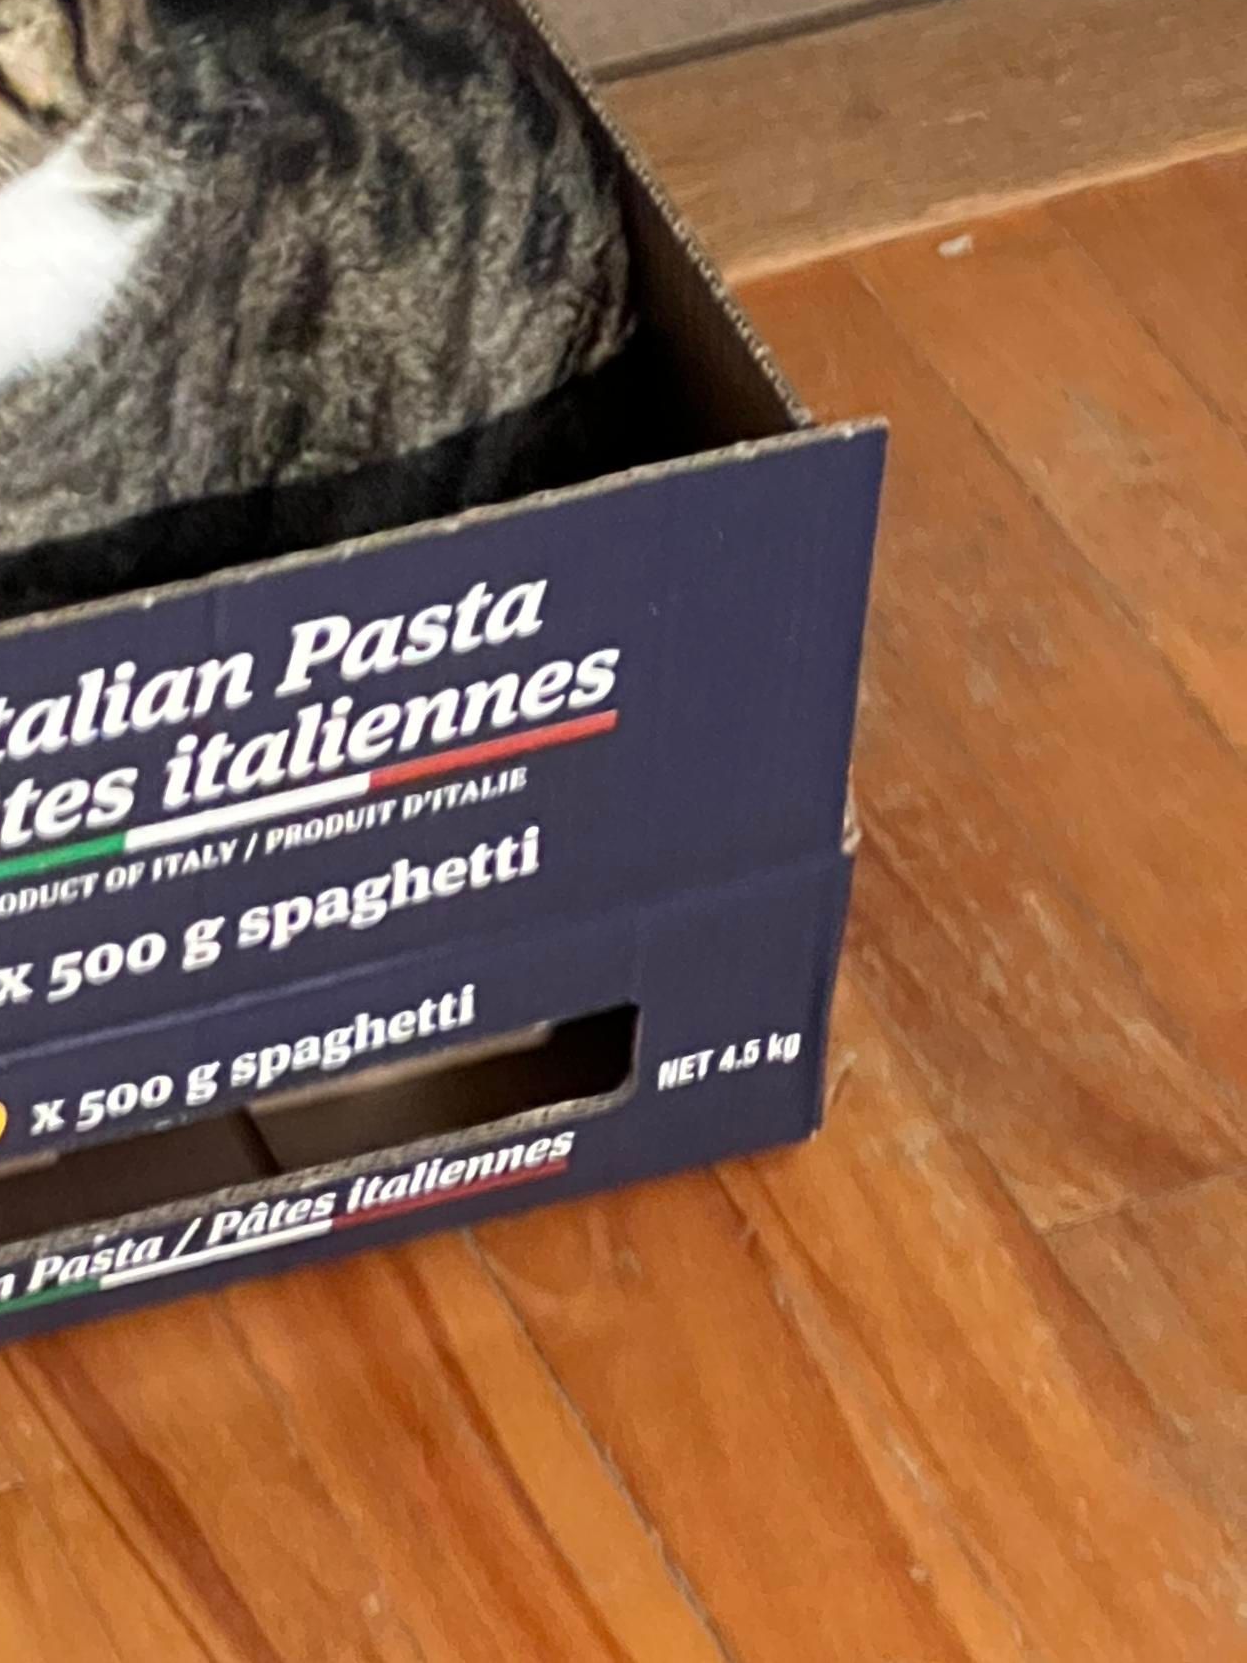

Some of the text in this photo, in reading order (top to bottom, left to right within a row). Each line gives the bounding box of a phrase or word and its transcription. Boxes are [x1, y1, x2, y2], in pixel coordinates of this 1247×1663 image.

[275, 578, 548, 697] Pasta
[162, 646, 621, 812] italiennes
[106, 862, 145, 893] OF
[152, 839, 228, 882] ITALY
[243, 832, 258, 863] /
[265, 799, 396, 855] PRODUIT
[402, 767, 528, 821] D'ITALIE
[46, 928, 167, 1003] 500
[183, 917, 225, 970] g
[237, 826, 540, 949] spaghetti
[30, 1097, 65, 1135] x
[75, 1074, 173, 1131] 500
[185, 1059, 221, 1105] g
[231, 984, 475, 1089] spaghetti
[658, 1049, 714, 1091] NET
[767, 1032, 801, 1064] kg
[27, 1235, 164, 1293] Pasta
[170, 1217, 202, 1258] /
[206, 1192, 337, 1246] Pâtes
[346, 1130, 575, 1214] italiennes
